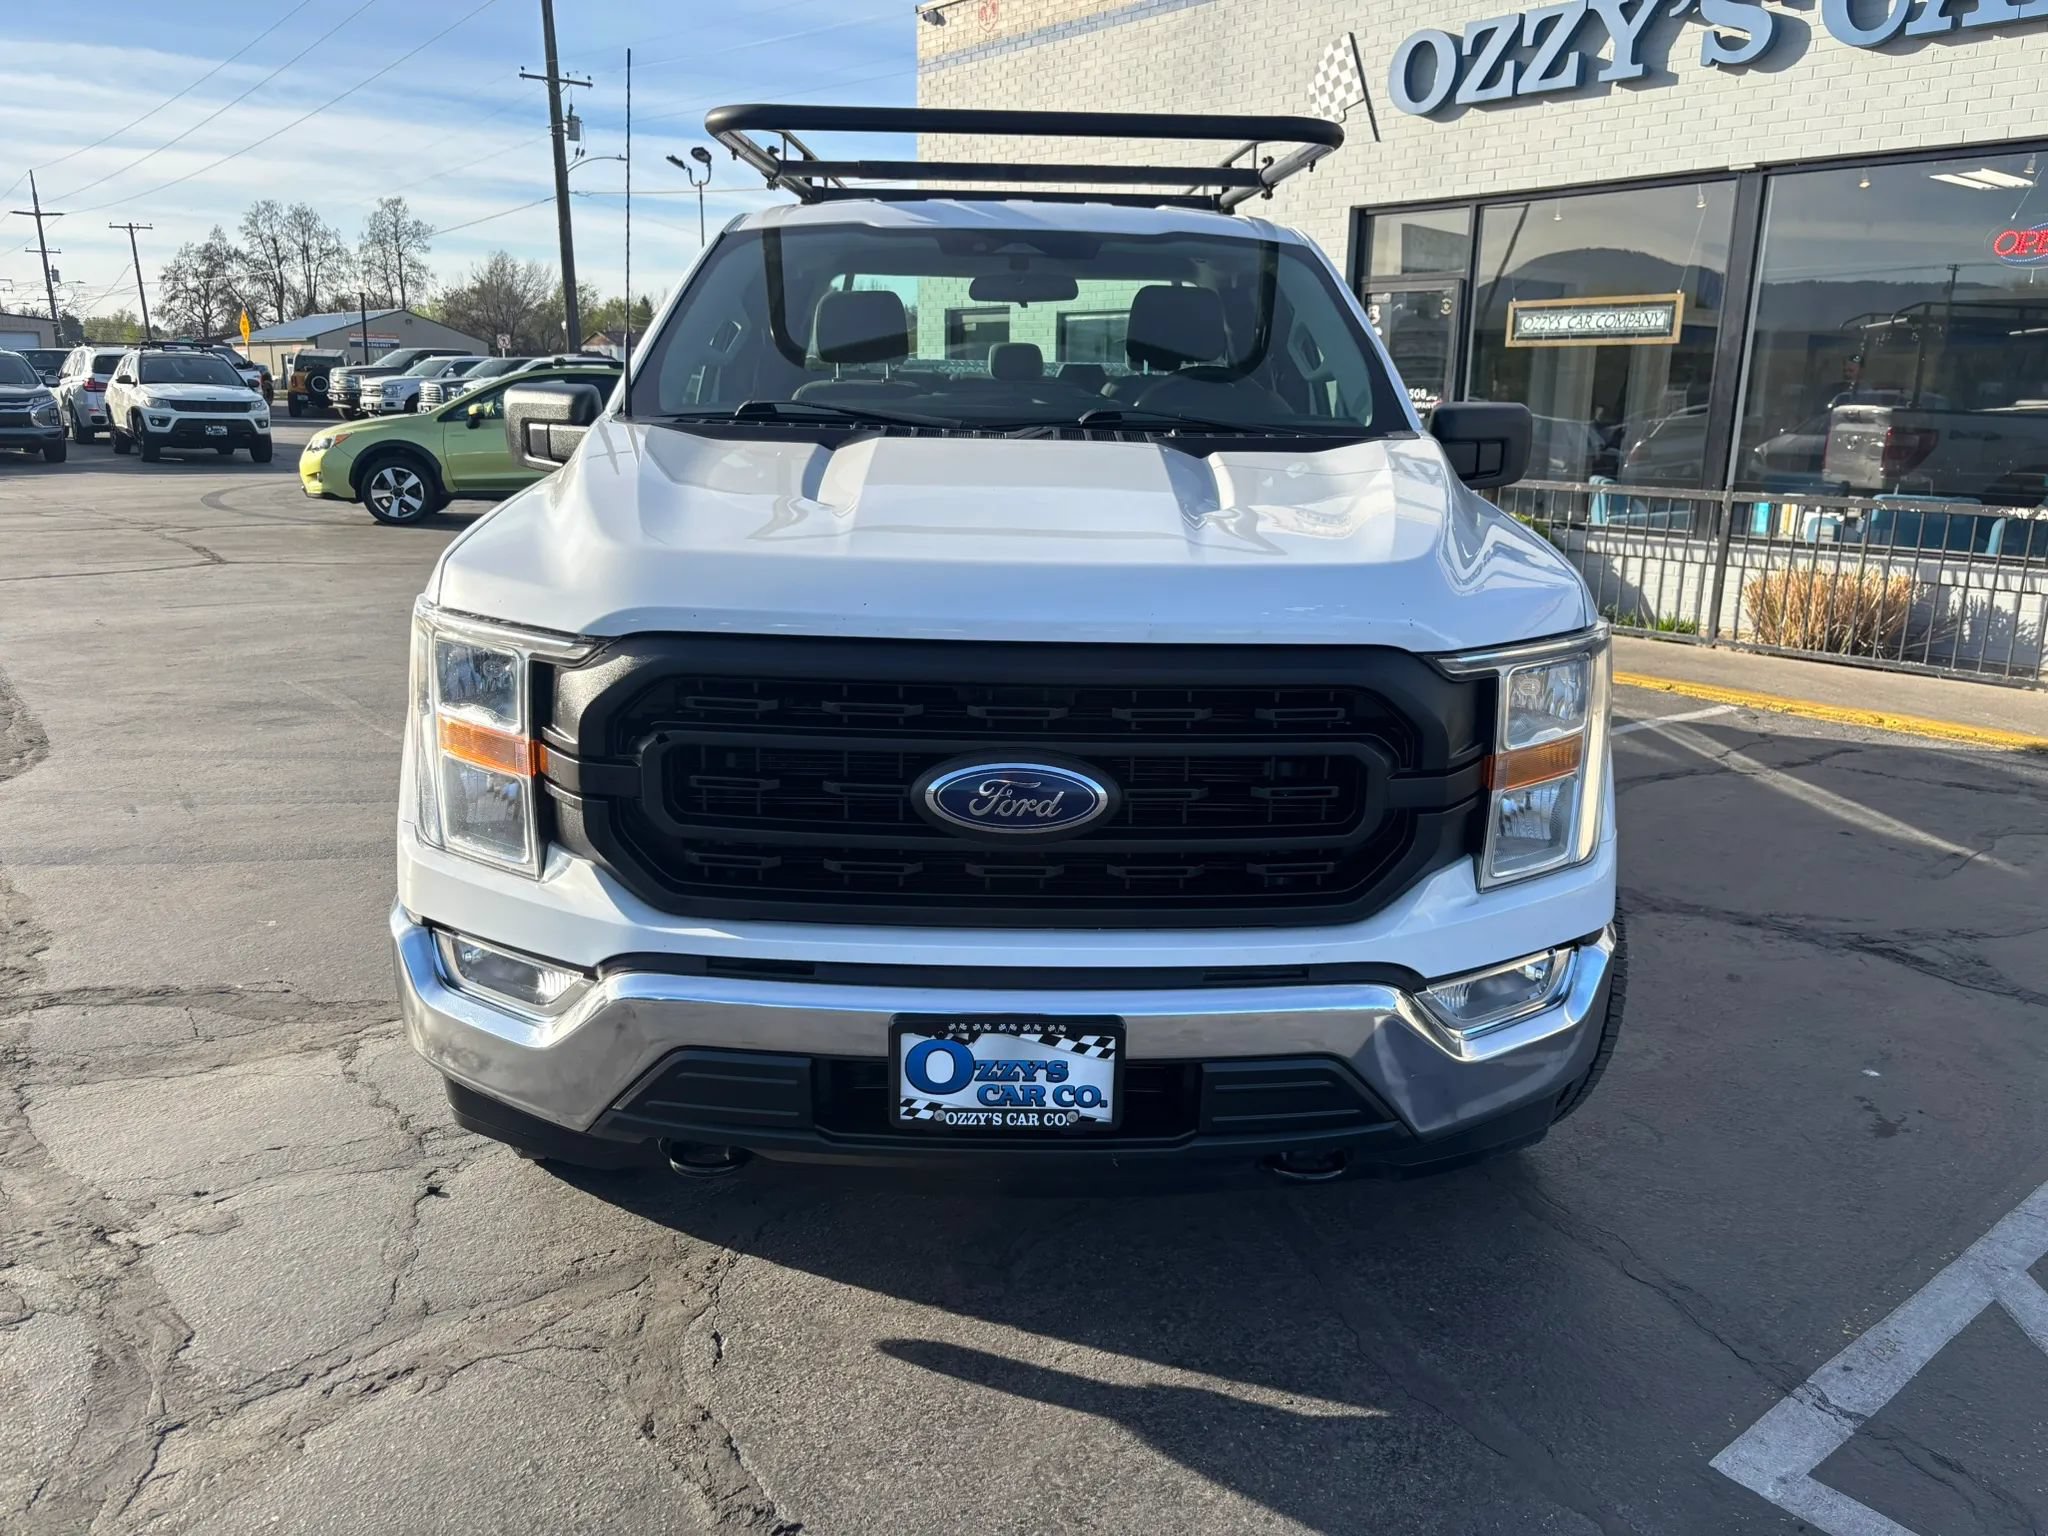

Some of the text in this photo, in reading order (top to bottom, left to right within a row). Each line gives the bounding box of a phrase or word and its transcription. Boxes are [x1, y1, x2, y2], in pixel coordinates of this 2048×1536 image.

[1388, 0, 1774, 115] OZZY'S
[1522, 311, 1664, 330] OZZY'S CAR COMPANY
[968, 778, 1065, 817] Ford
[904, 1038, 1070, 1096] OZZY'S
[976, 1084, 1108, 1109] CAR CO.
[945, 1112, 1071, 1127] OZZY'S CAR CO.
